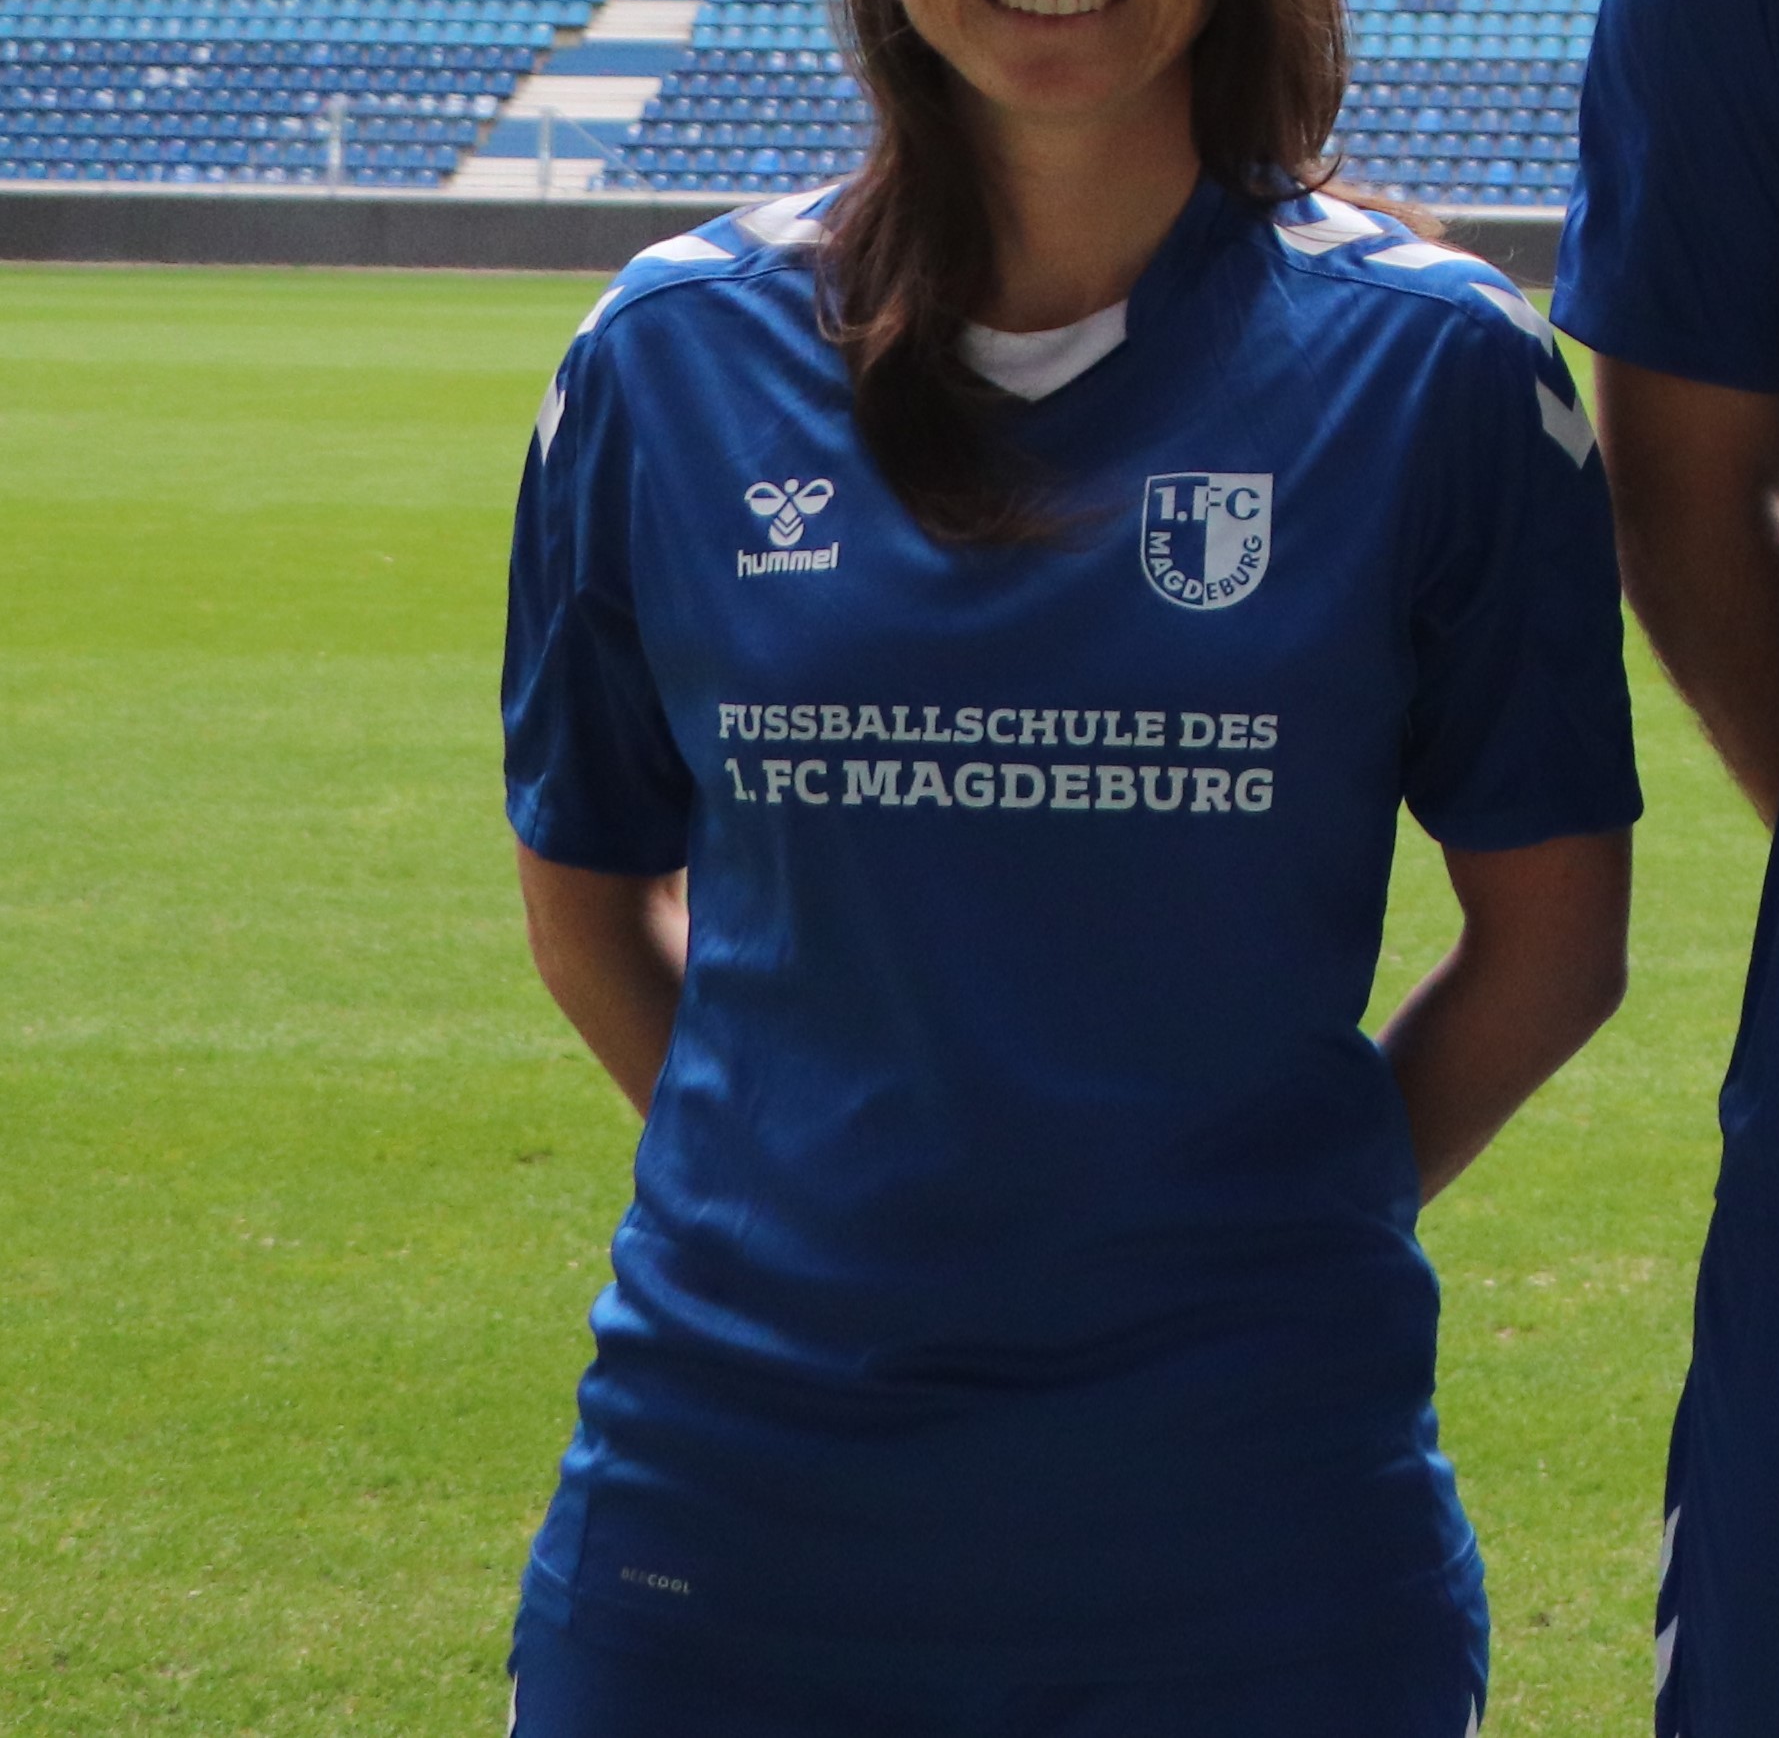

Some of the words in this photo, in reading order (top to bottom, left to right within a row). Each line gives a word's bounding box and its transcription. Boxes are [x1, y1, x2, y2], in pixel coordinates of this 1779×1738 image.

[737, 541, 839, 579] hummel
[1148, 530, 1263, 603] MAGDEBURG
[717, 702, 1167, 747] FUSSBALLSCHULE
[1178, 711, 1279, 751] DES
[724, 757, 757, 803] 1.
[764, 759, 829, 805] FC
[841, 759, 1275, 813] MAGDEBURG
